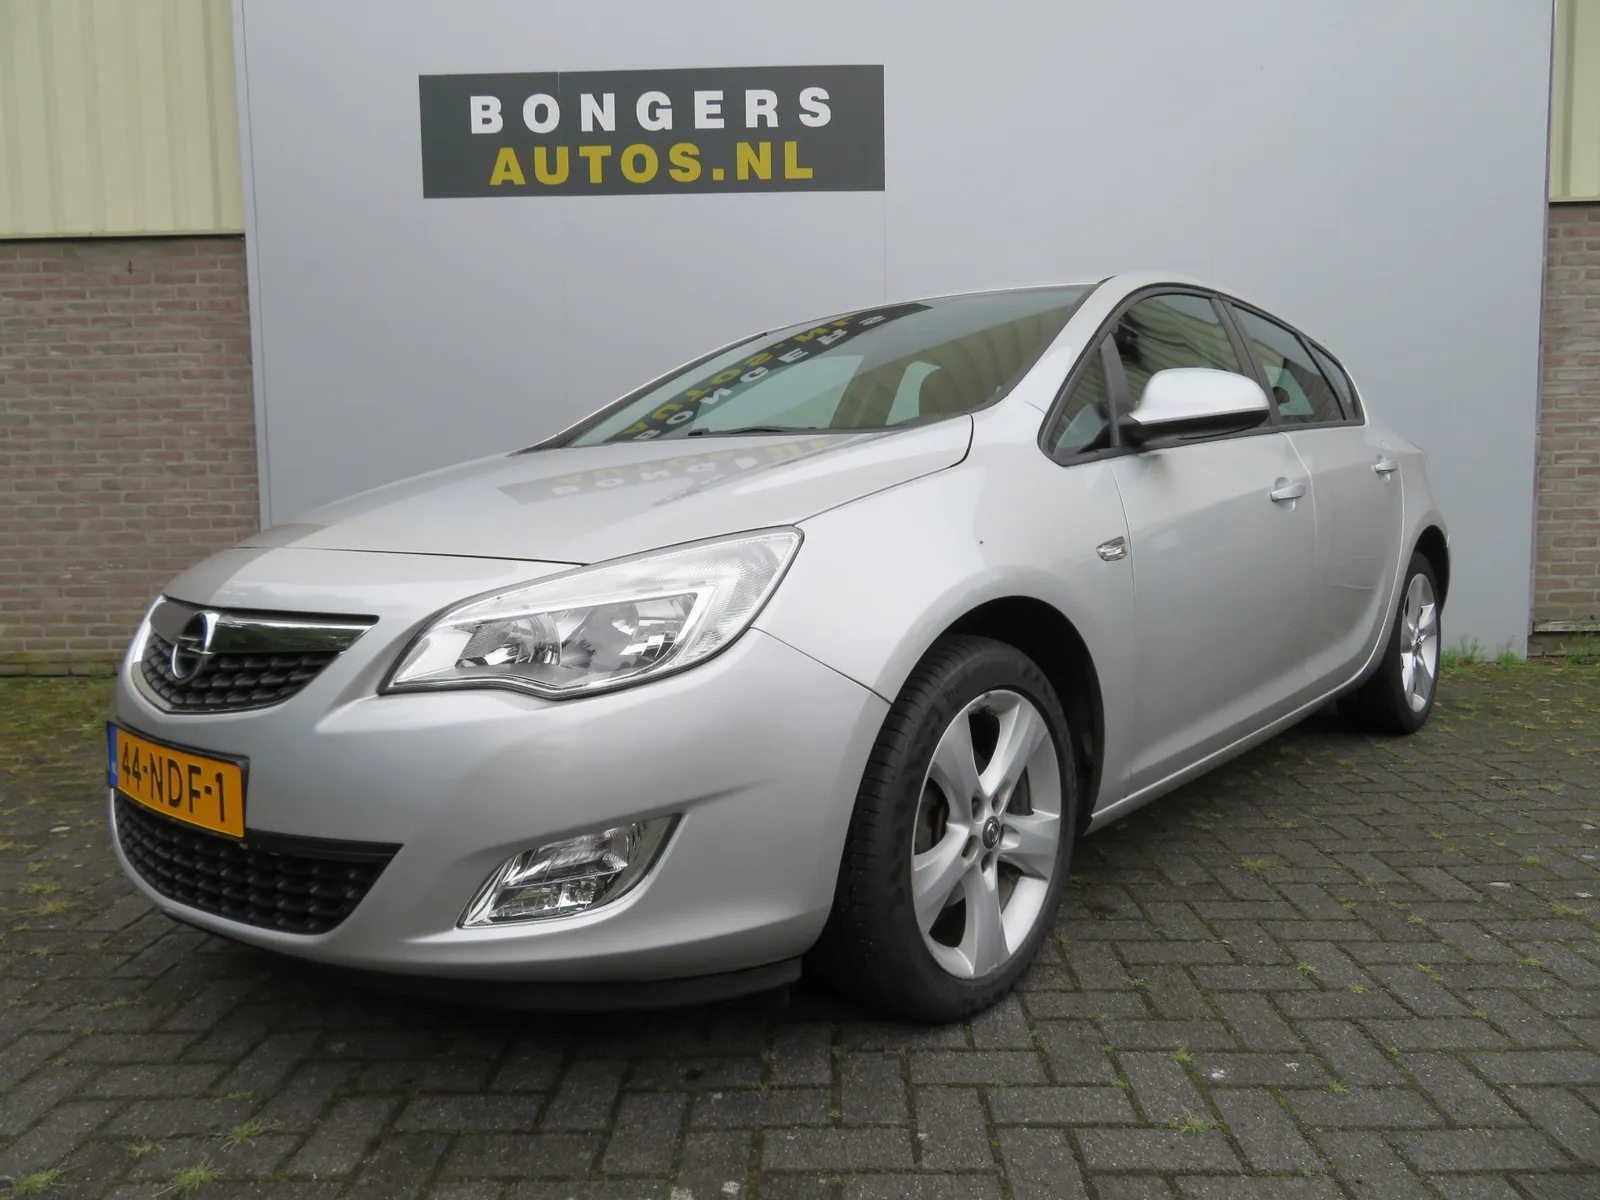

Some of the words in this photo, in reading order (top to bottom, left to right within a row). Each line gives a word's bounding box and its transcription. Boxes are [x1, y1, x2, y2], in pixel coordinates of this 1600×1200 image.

[470, 87, 832, 135] BONGERS
[489, 141, 813, 186] AUTOS.NL
[122, 741, 225, 822] 44-NDF-1
